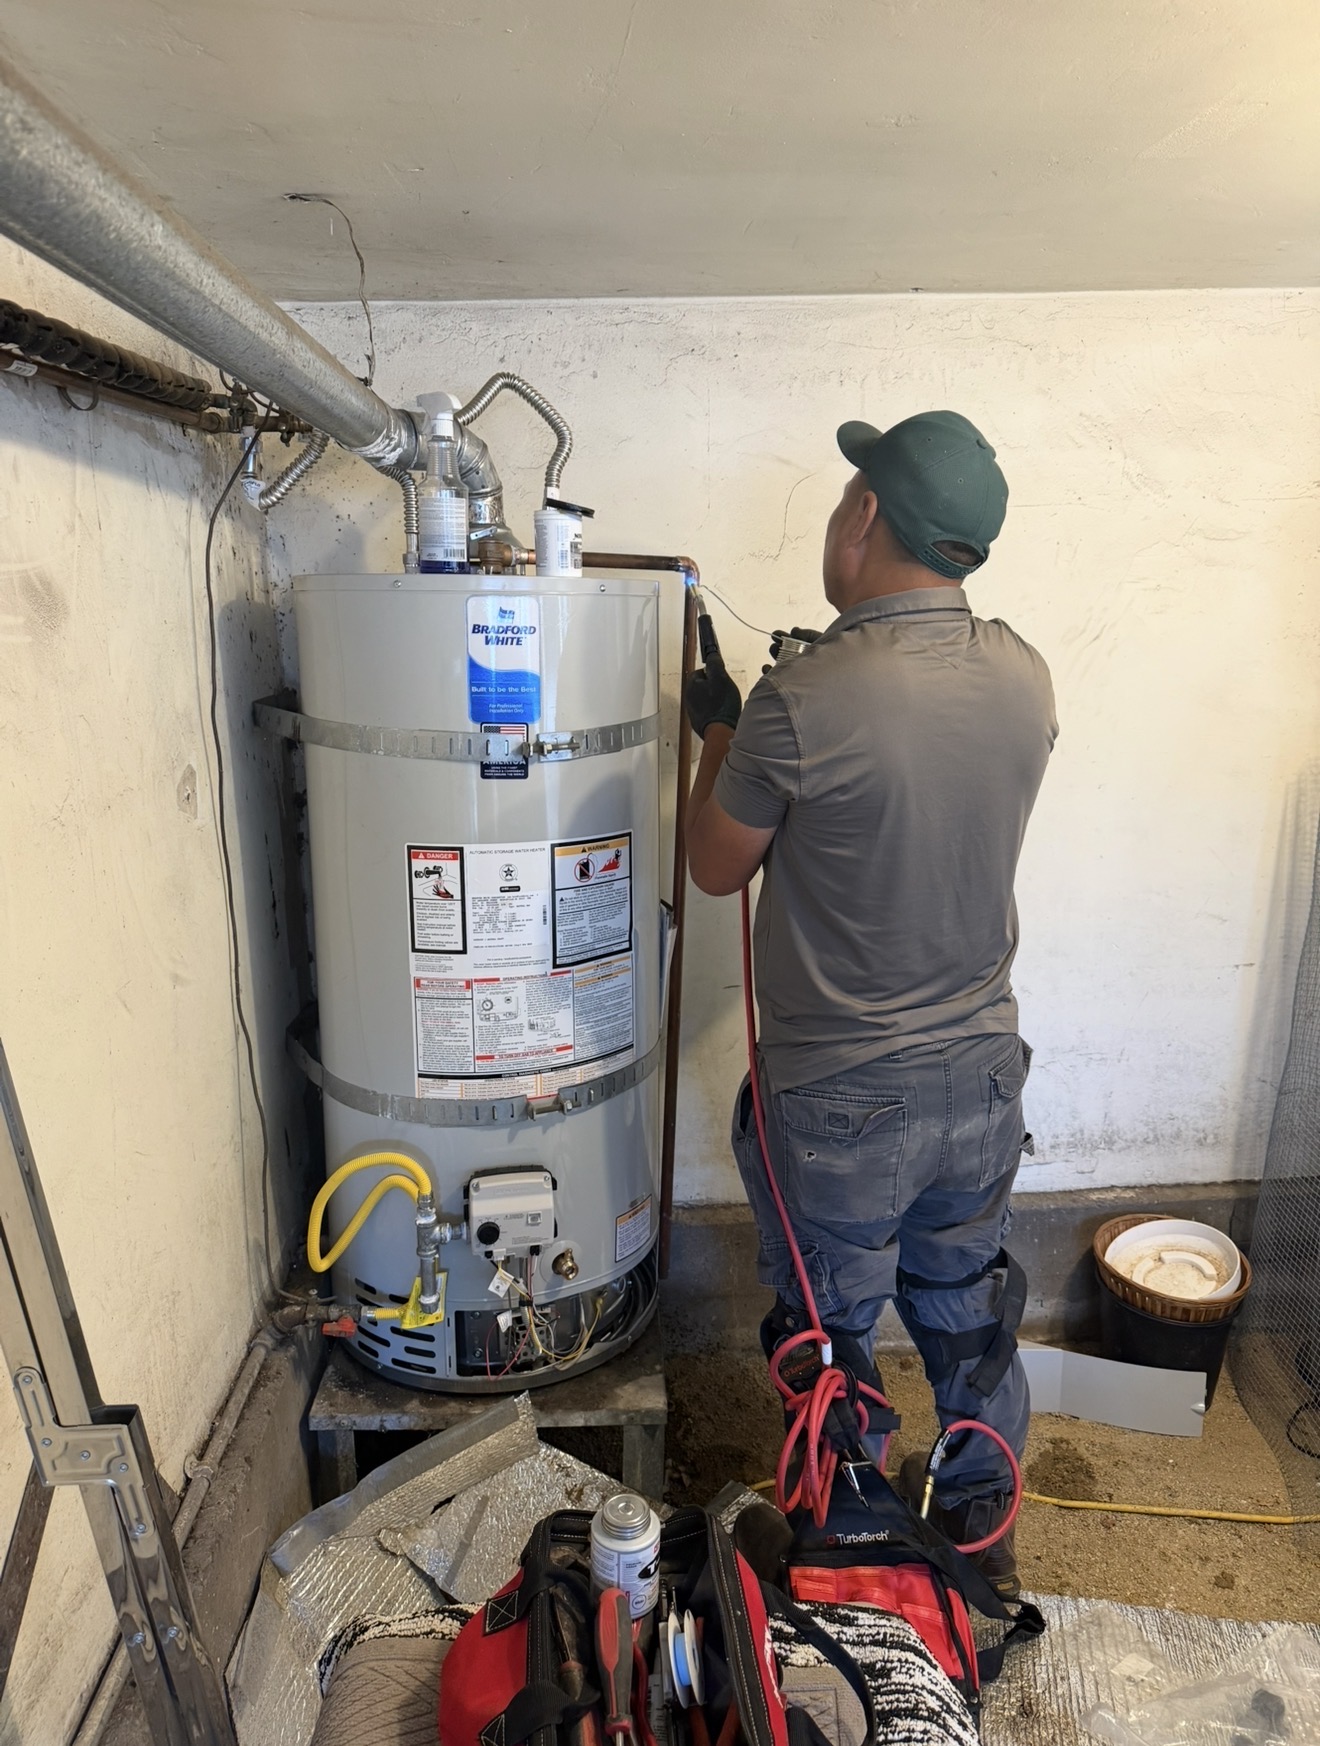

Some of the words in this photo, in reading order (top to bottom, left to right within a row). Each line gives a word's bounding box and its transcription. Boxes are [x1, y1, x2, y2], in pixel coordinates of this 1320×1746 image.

[472, 624, 536, 635] BRADFORD
[484, 635, 523, 645] WHITE
[587, 843, 610, 851] WARNING
